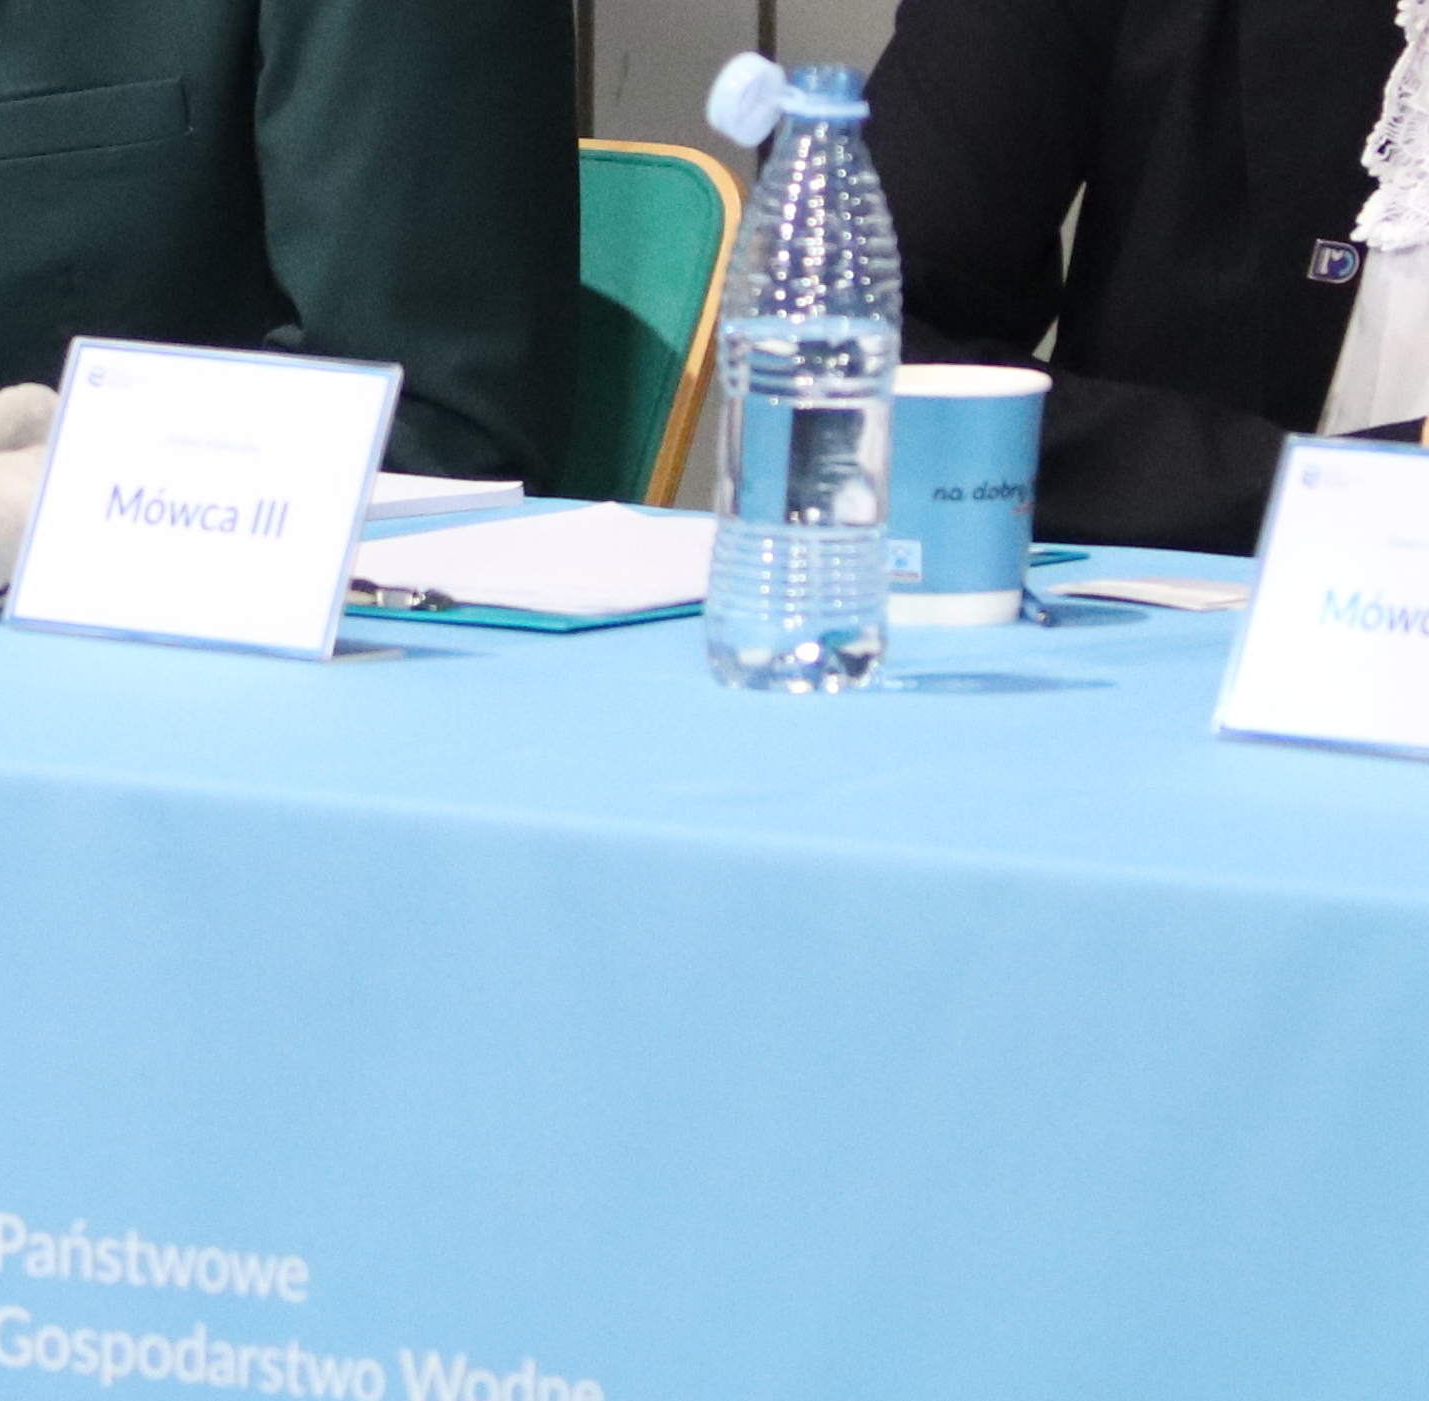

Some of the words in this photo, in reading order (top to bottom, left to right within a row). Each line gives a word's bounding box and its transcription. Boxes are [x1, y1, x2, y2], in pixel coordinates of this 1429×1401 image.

[105, 483, 239, 533] Mówca
[250, 499, 288, 538] III
[933, 486, 963, 501] na
